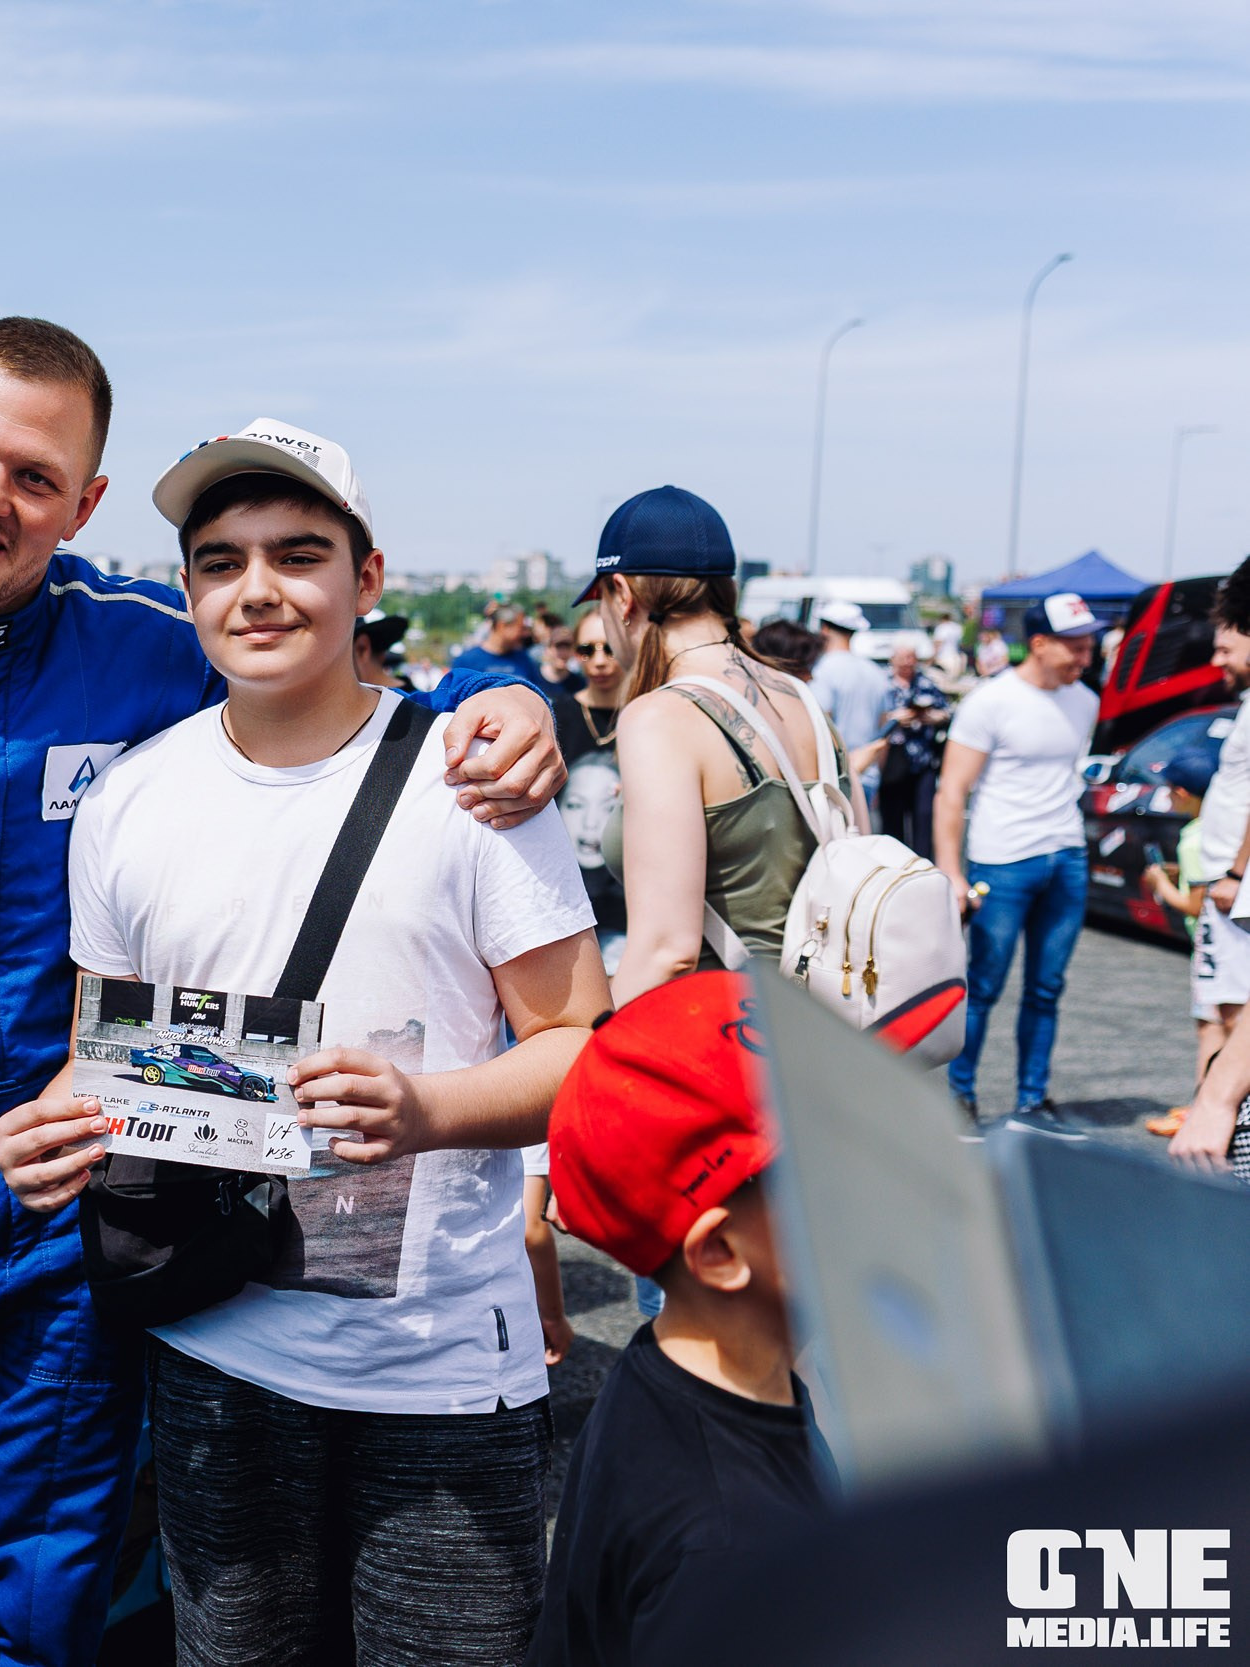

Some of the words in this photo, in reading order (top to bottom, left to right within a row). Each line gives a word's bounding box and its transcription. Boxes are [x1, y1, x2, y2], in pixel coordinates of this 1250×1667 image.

[180, 998, 220, 1011] HUNTERS
[103, 1096, 131, 1105] LAKE
[226, 1137, 254, 1146] МАСТЕРА
